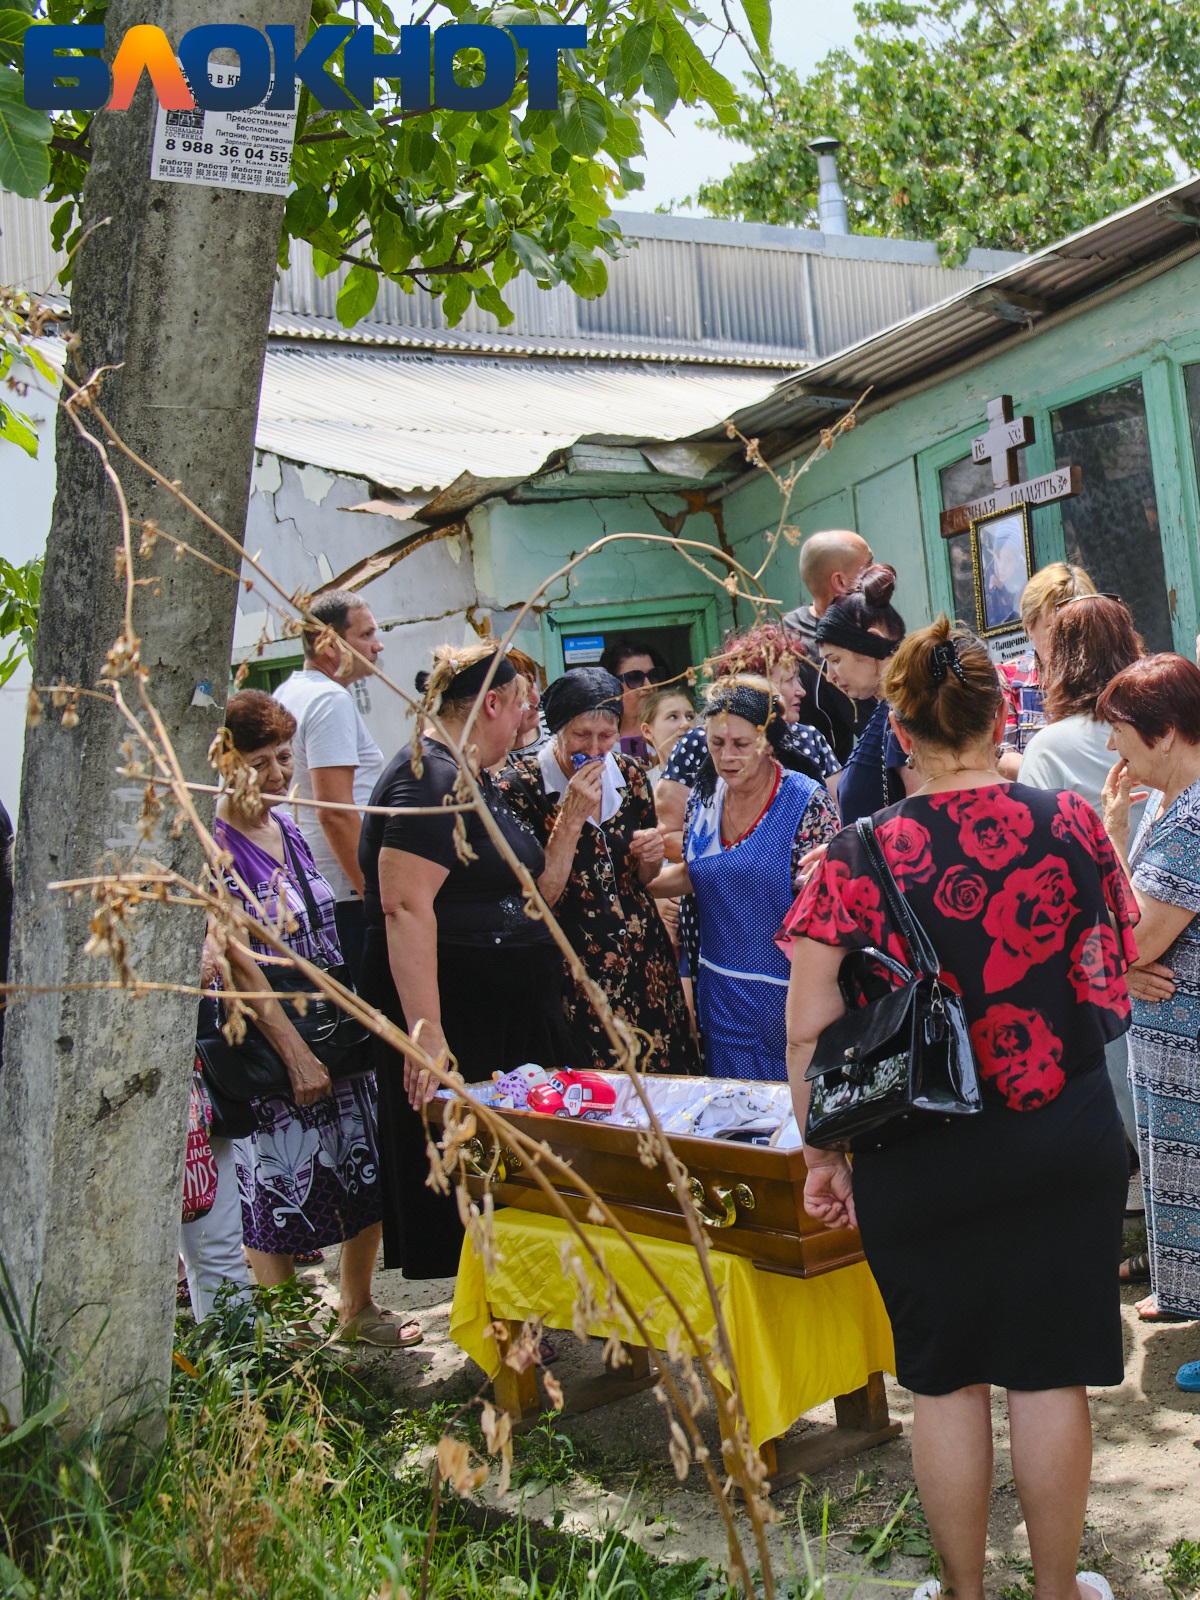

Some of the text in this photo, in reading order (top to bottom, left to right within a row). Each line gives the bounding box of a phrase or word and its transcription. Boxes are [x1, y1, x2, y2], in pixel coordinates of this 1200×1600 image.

[226, 113, 290, 128] Предоставляем:
[166, 126, 204, 134] СОЦИАЛЬНАЯ
[216, 129, 250, 140] Питание,
[236, 123, 279, 135] Бесплатное
[164, 132, 203, 140] ГОСТИНИЦА
[166, 138, 176, 150] 8
[182, 141, 214, 154] 988
[219, 144, 239, 157] 36
[244, 148, 264, 160] 04
[225, 138, 286, 151] Зарплата договорная
[160, 158, 193, 167] Работа
[197, 162, 228, 171] Работа
[246, 160, 283, 169] Камская
[232, 166, 262, 174] Работа
[1010, 478, 1058, 506] ПАМЯТЬ
[188, 1132, 206, 1147] TY
[183, 1154, 218, 1199] NDS
